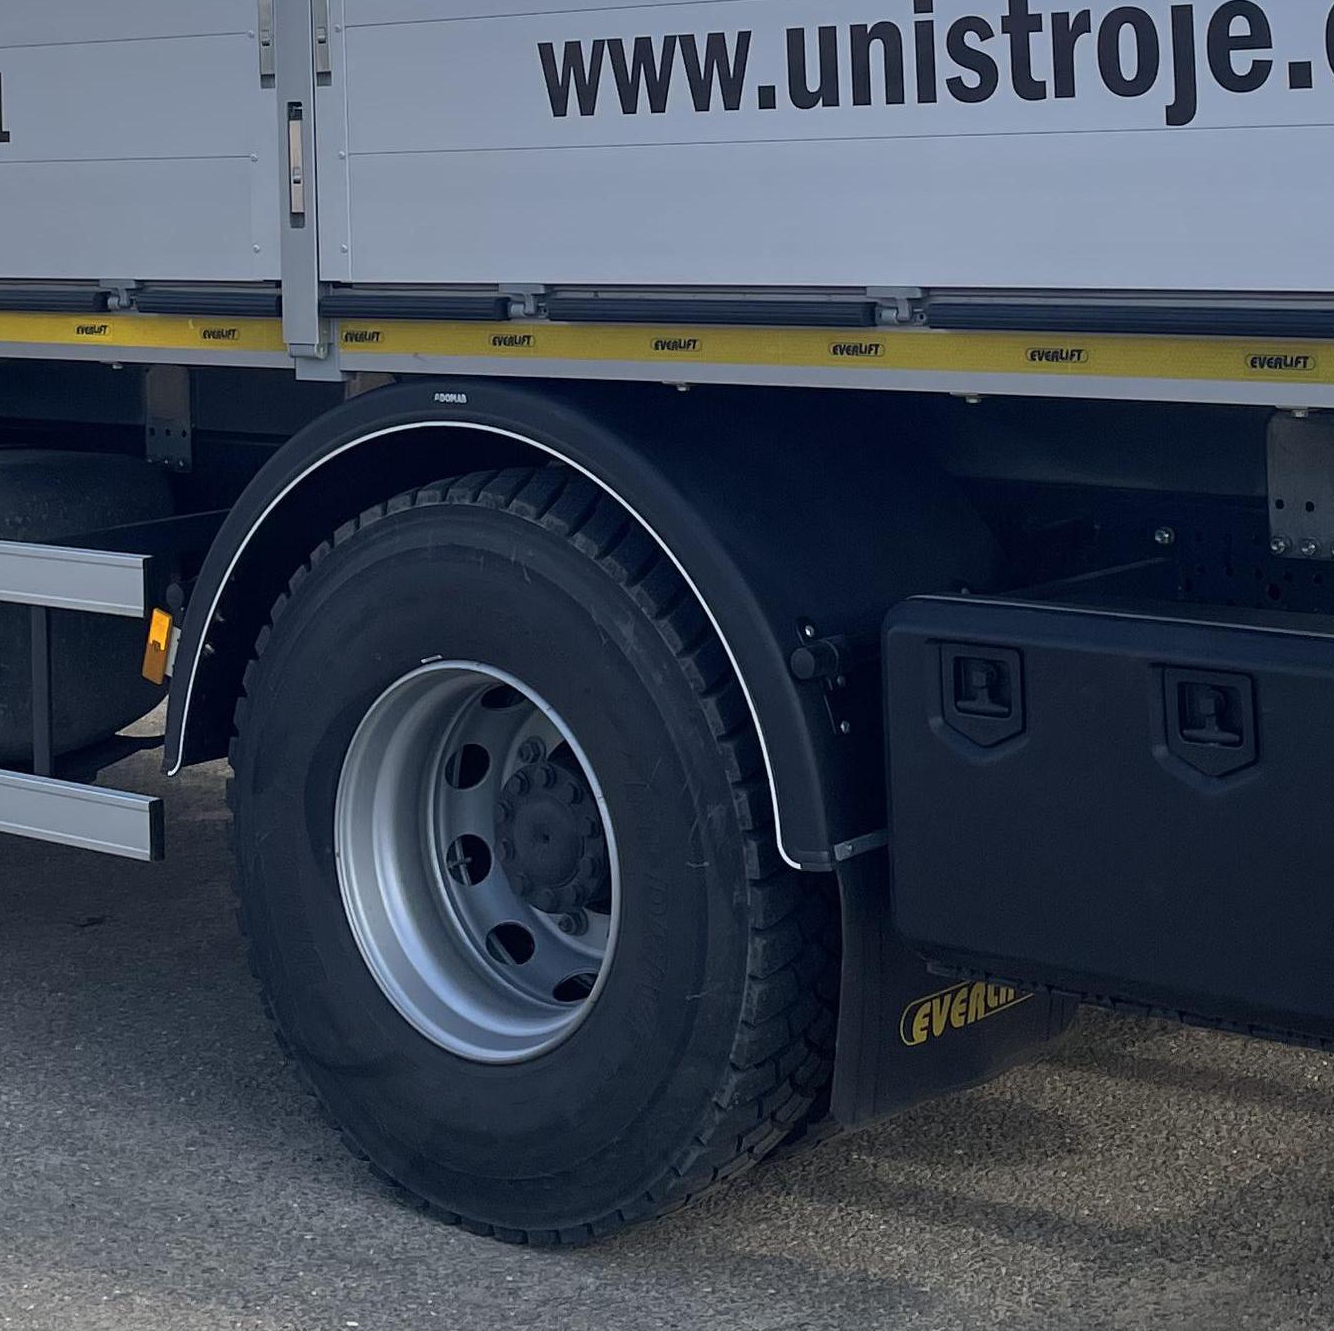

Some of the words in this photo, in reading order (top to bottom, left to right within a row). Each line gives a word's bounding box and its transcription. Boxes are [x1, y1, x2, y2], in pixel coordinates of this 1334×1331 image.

[492, 334, 533, 347] EVERLIFT
[654, 338, 699, 351] EVERLIFT
[832, 343, 880, 356] EVERLIFT
[1030, 348, 1084, 363] EVERLIFT
[1250, 355, 1309, 370] EVERLIFT
[912, 981, 1015, 1043] EVERLI
